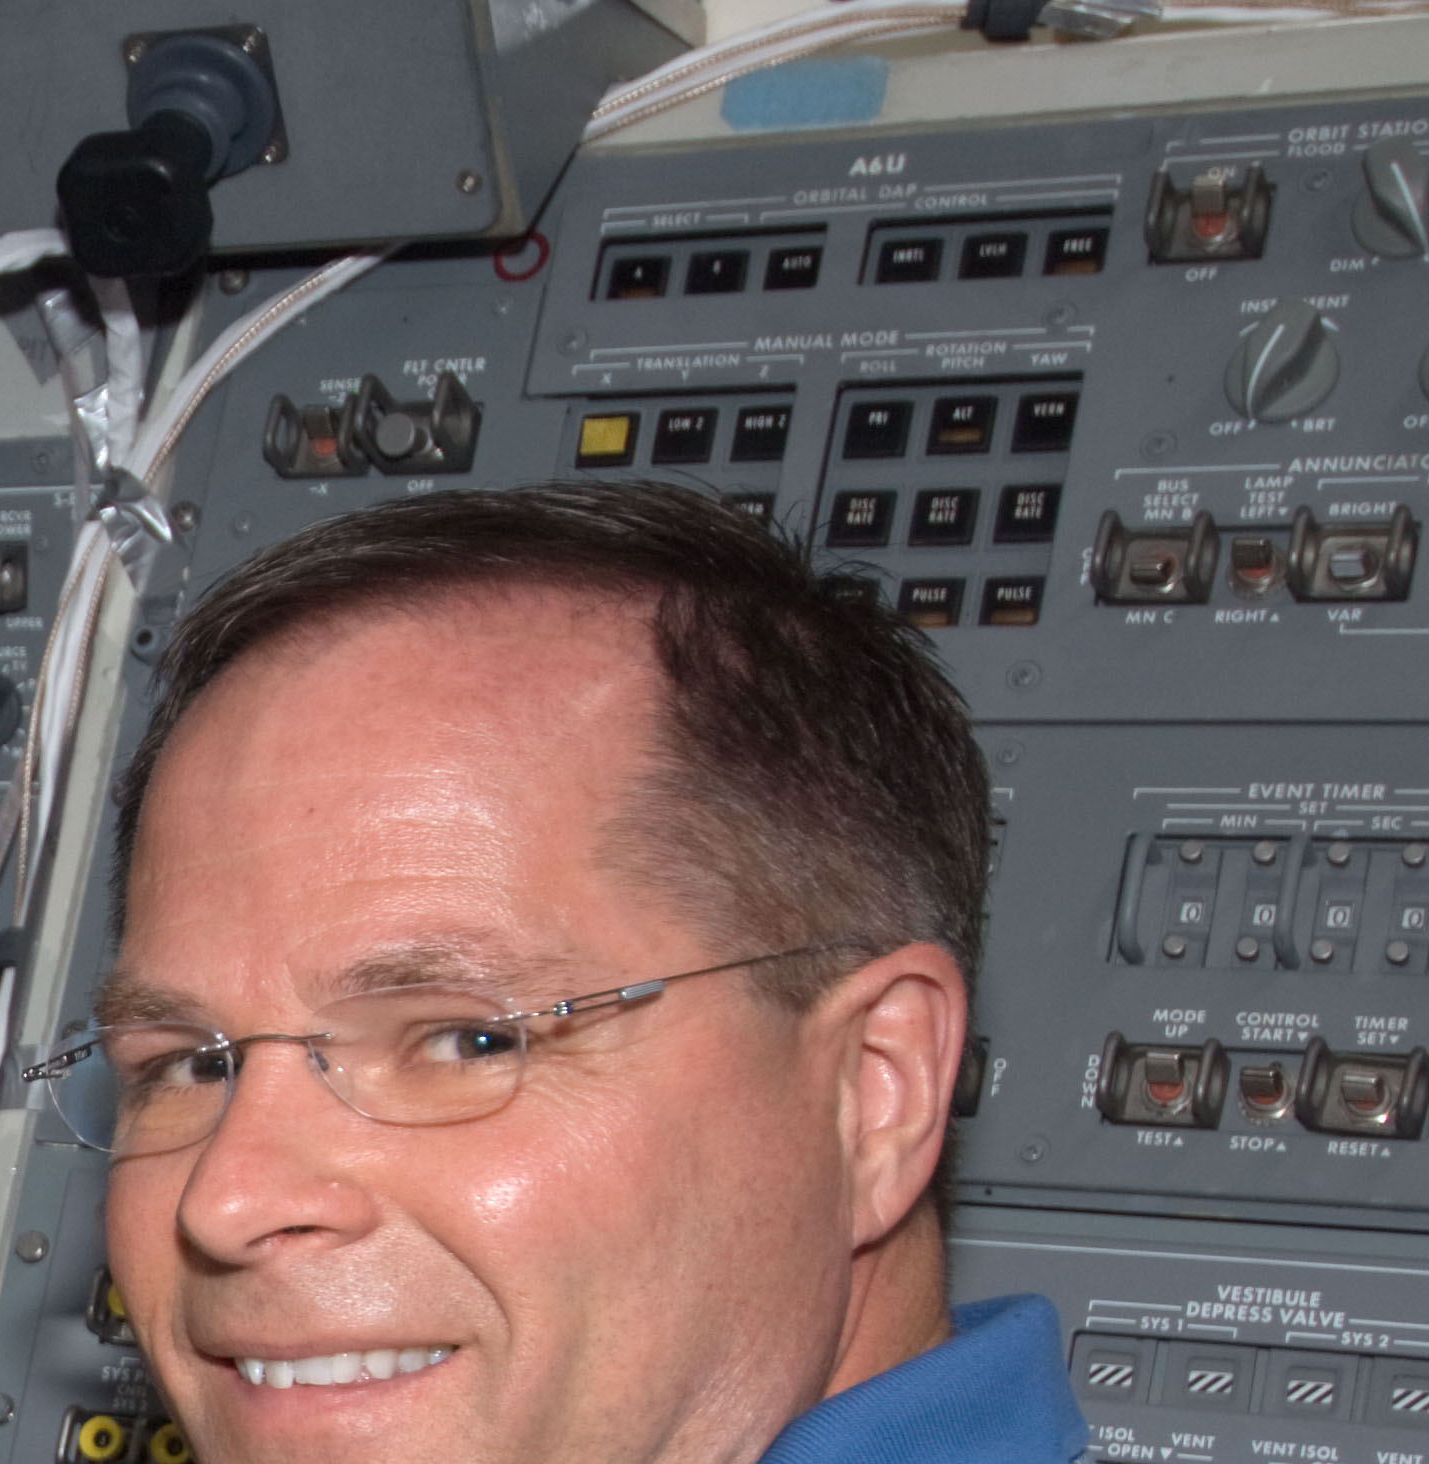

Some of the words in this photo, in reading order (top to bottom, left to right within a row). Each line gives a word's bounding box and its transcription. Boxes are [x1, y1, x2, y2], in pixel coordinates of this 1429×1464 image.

[1288, 125, 1349, 144] ORBIT
[1287, 144, 1346, 157] FLOOD
[847, 153, 908, 177] A6U
[792, 186, 867, 207] ORBITAL
[878, 182, 918, 200] DAP
[914, 193, 989, 210] CONTROL
[651, 211, 701, 227] SELECT
[1063, 236, 1093, 253] FREE
[1329, 258, 1365, 273] DIM
[1184, 267, 1218, 282] OFF
[753, 334, 833, 351] MANUAL
[841, 330, 900, 347] MODE
[925, 340, 1007, 358] ROTATION
[402, 358, 428, 375] FLT
[636, 353, 740, 370] TRANSLATION
[940, 355, 986, 370] PITCH
[1029, 352, 1069, 367] YAW
[1209, 421, 1242, 436] OFF
[1302, 417, 1335, 432] BRT
[406, 479, 435, 494] OFF
[1157, 478, 1189, 493] BUS
[1244, 476, 1293, 490] LAMP
[1143, 493, 1200, 507] SELECT
[1248, 491, 1285, 505] TEST
[1143, 507, 1174, 521] MN
[1240, 505, 1274, 519] LEFT
[1328, 501, 1398, 517] BRIGHT
[912, 587, 947, 603] PULSE
[996, 586, 1033, 601] PULSE
[1125, 610, 1156, 625] MN
[1163, 609, 1174, 624] C
[1214, 609, 1268, 624] RIGHT
[1327, 608, 1363, 622] VAR
[1247, 783, 1315, 799] EVENT
[1322, 783, 1387, 800] TIMER
[1299, 802, 1329, 815] SET
[1220, 815, 1258, 828] MIN
[1371, 817, 1403, 831] SEC
[1152, 1008, 1207, 1025] MODE
[1235, 1011, 1320, 1029] CONTROL
[1354, 1015, 1410, 1032] TIMER
[1164, 1024, 1190, 1039] UP
[1240, 1027, 1295, 1042] START
[1357, 1030, 1389, 1046] SET
[1080, 1054, 1101, 1109] DOWN
[1136, 1131, 1173, 1147] TEST
[1229, 1135, 1276, 1152] STOP
[1327, 1140, 1380, 1158] RESET
[1216, 1284, 1323, 1308] VESTIBULE
[1185, 1300, 1273, 1324] DEPRESS
[1279, 1308, 1347, 1329] VALVE
[1139, 1316, 1173, 1332] SYS
[1175, 1318, 1185, 1332] 1
[1340, 1331, 1374, 1347] SYS
[1377, 1334, 1391, 1349] 2
[1098, 1426, 1137, 1443] ISOL
[1170, 1432, 1217, 1449] VENT
[1106, 1443, 1155, 1460] OPEN
[1250, 1439, 1298, 1457] VENT
[1299, 1444, 1340, 1462] ISOL
